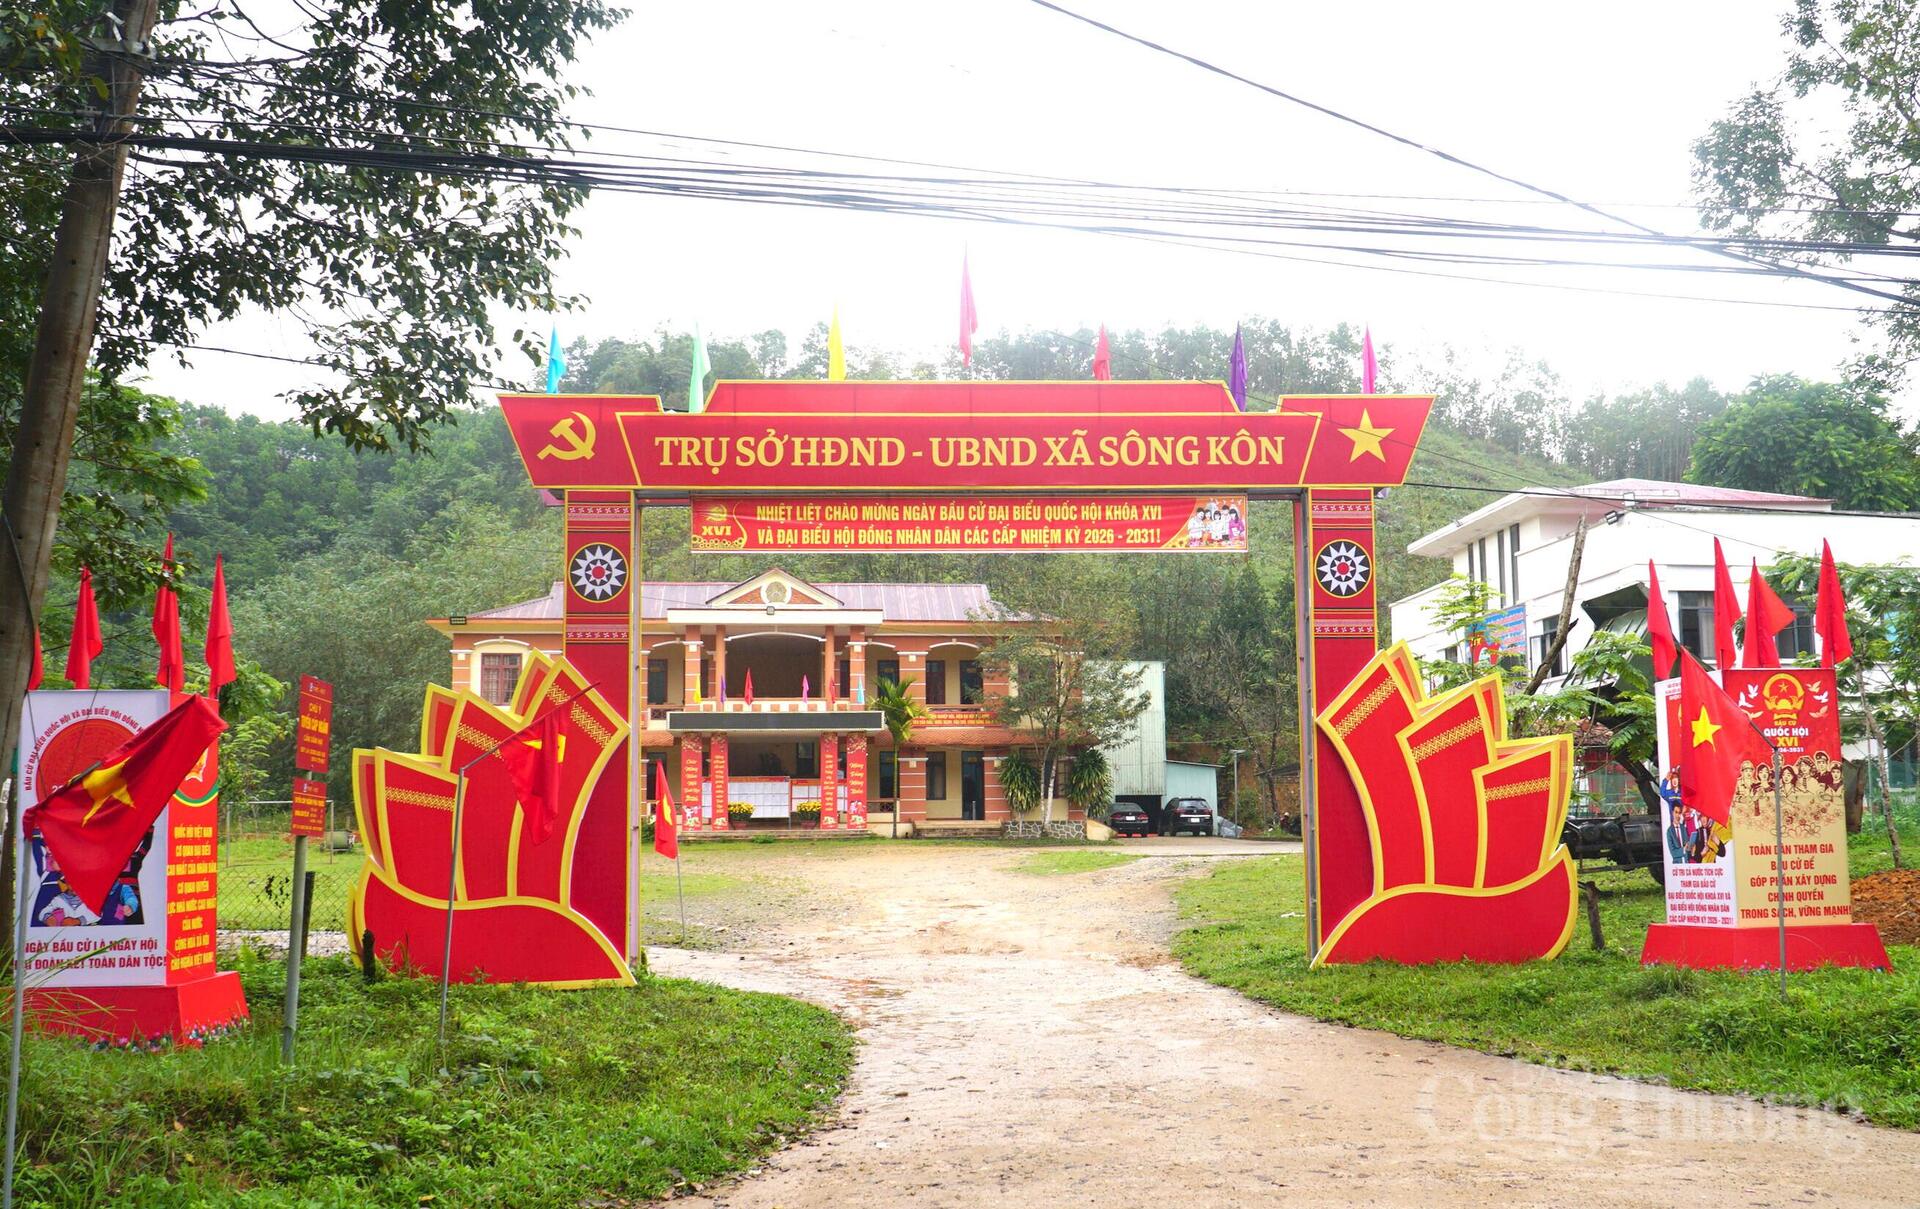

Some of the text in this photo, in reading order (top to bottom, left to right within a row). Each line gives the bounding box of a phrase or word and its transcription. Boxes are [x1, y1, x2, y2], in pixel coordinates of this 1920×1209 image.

[655, 436, 730, 475] TRỤ
[736, 429, 788, 467] SỞ
[791, 437, 905, 466] HĐND
[930, 437, 1038, 466] UBND
[1043, 429, 1094, 466] XÃ
[1100, 428, 1201, 466] SÔNG
[1206, 428, 1284, 466] KÔN
[757, 500, 1162, 524] NHIỆT LIỆT CHÀO MỪNG NGÀY BẦU CỬ ĐẠI BIỂU QUỐC HỘI KHÓA XVI
[702, 525, 732, 536] XVI
[757, 526, 775, 544] VÀ
[777, 528, 798, 548] ĐẠI
[802, 523, 830, 544] BIỂU
[833, 526, 854, 547] HỘI
[858, 524, 893, 544] ĐỒNG
[896, 526, 931, 544] NHÂN
[934, 526, 961, 544] DÂN
[964, 526, 989, 544] CÁC
[992, 524, 1017, 544] CẤP
[1021, 526, 1061, 547] NHIỆM
[1065, 526, 1081, 544] KỲ
[1084, 529, 1114, 544] 2026
[1126, 528, 1161, 543] 2031!
[1764, 726, 1809, 738] QUỐC HỘI
[1776, 736, 1798, 747] XVI
[1749, 843, 1772, 855] TOÀN
[1794, 844, 1818, 854] THAM
[1820, 843, 1834, 853] GIA
[1771, 856, 1815, 870] BU CỬ ĐỂ
[1750, 875, 1767, 887] GÓP
[1795, 874, 1812, 886] XÂY
[1768, 888, 1824, 902] CHNH QUYỀN
[1740, 908, 1769, 919] TRONG
[1799, 905, 1821, 917] VỮNG
[1823, 905, 1852, 918] MẠNH!
[53, 938, 73, 952] BẦU
[77, 938, 92, 952] CỬ
[88, 955, 116, 969] TOÀN
[119, 955, 140, 968] DÂN
